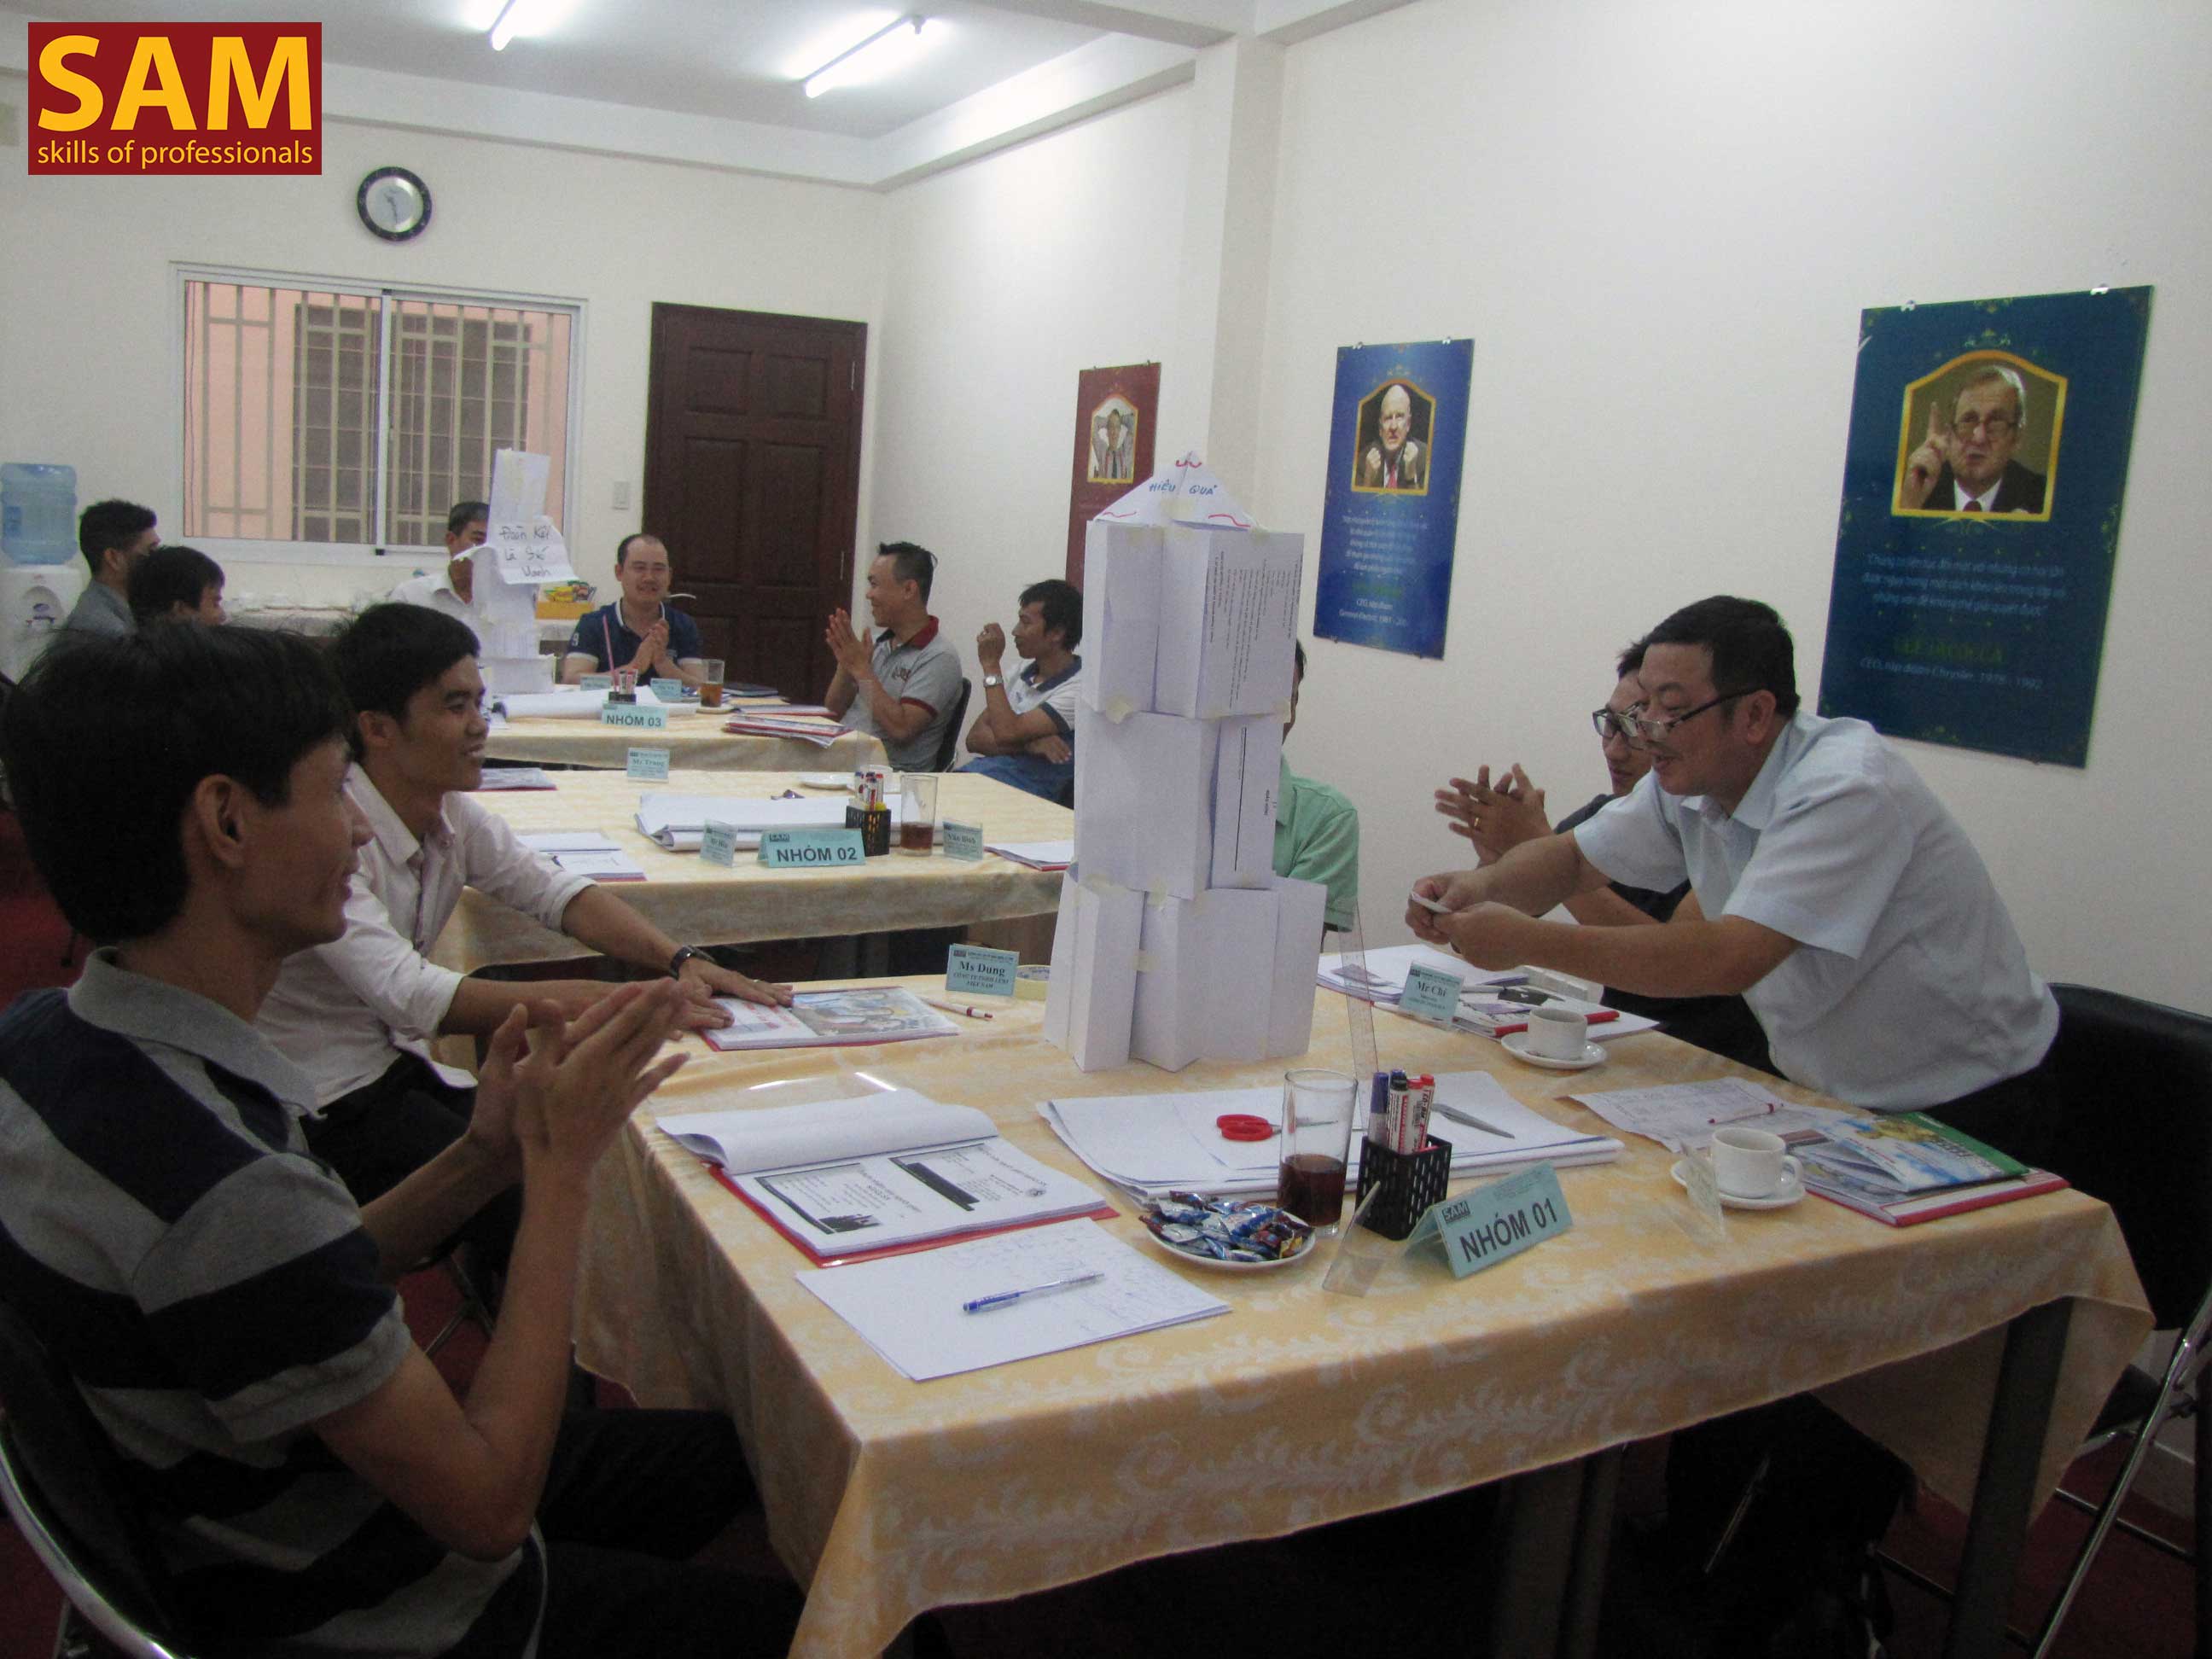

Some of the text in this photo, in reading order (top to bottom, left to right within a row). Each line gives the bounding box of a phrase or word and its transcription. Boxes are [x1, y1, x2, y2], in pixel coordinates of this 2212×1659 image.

[648, 717, 662, 727] 03
[837, 847, 858, 861] 02
[959, 960, 975, 971] Ms
[1442, 1202, 1470, 1222] SAM
[1460, 1197, 1558, 1262] NHÓM 01
